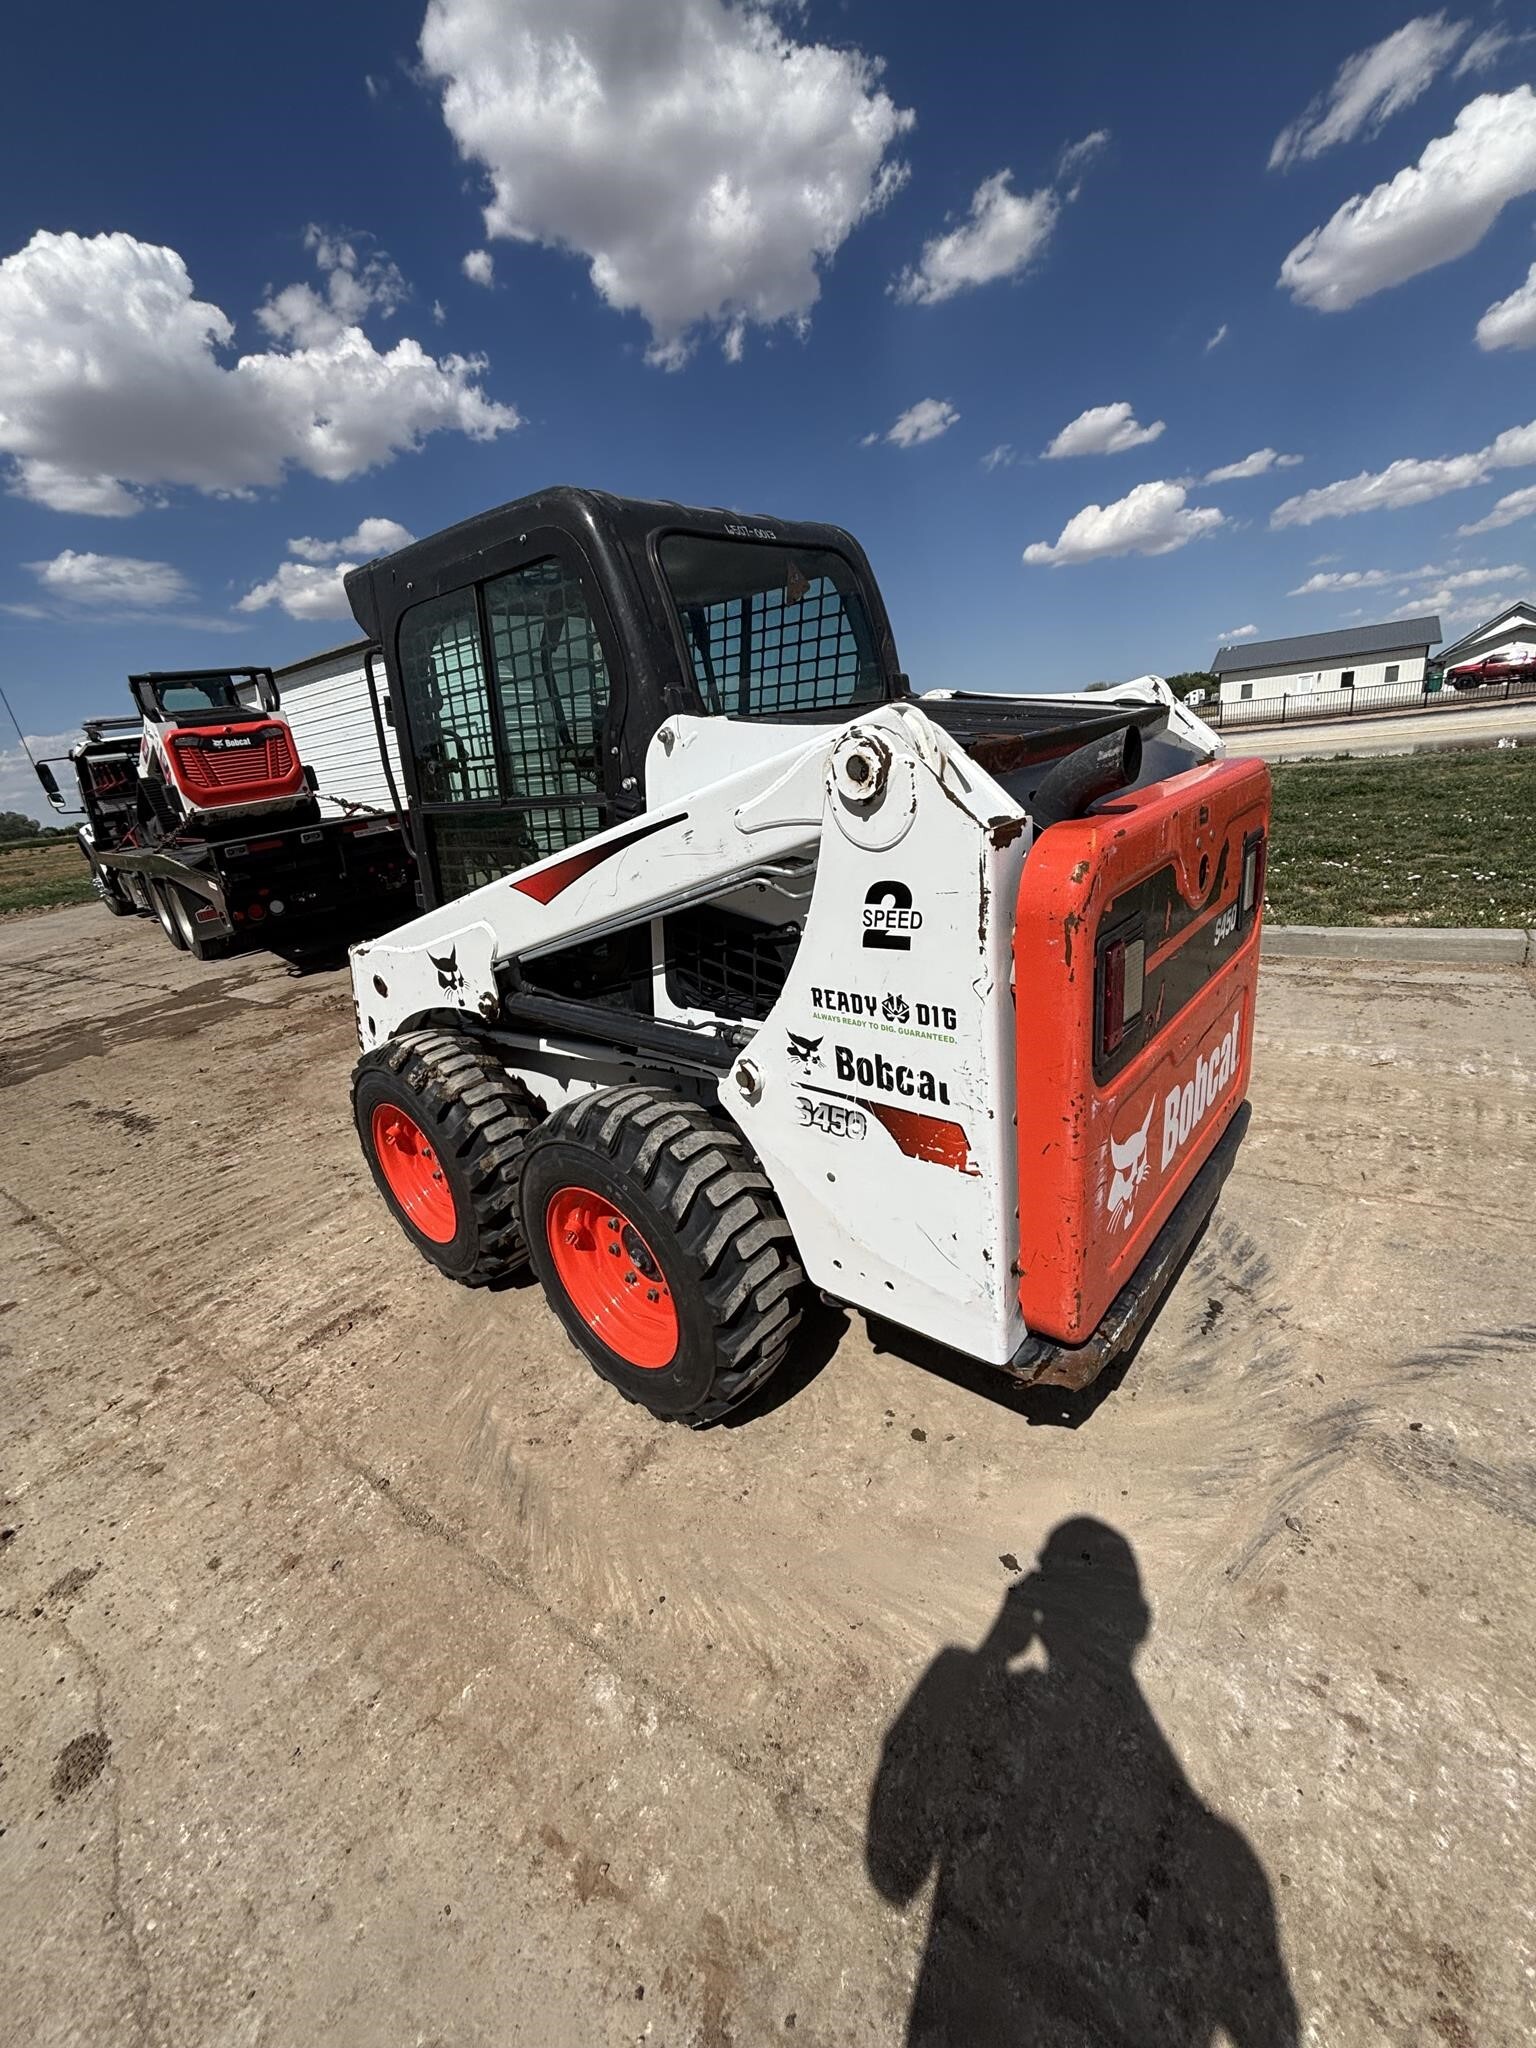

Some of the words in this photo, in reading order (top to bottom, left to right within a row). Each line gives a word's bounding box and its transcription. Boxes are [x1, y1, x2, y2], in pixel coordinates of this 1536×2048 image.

[224, 738, 251, 747] Bobcat
[862, 880, 913, 951] 2
[862, 908, 923, 930] SPEED
[1213, 903, 1238, 947] S450
[811, 987, 877, 1017] READY
[915, 1003, 957, 1031] DIG
[812, 1011, 842, 1023] ALWAYS
[842, 1016, 867, 1028] READY
[868, 1021, 879, 1030] TO
[880, 1024, 897, 1034] DIG.
[897, 1026, 958, 1045] GUARANTEED.
[1161, 1010, 1240, 1174] Bobcat
